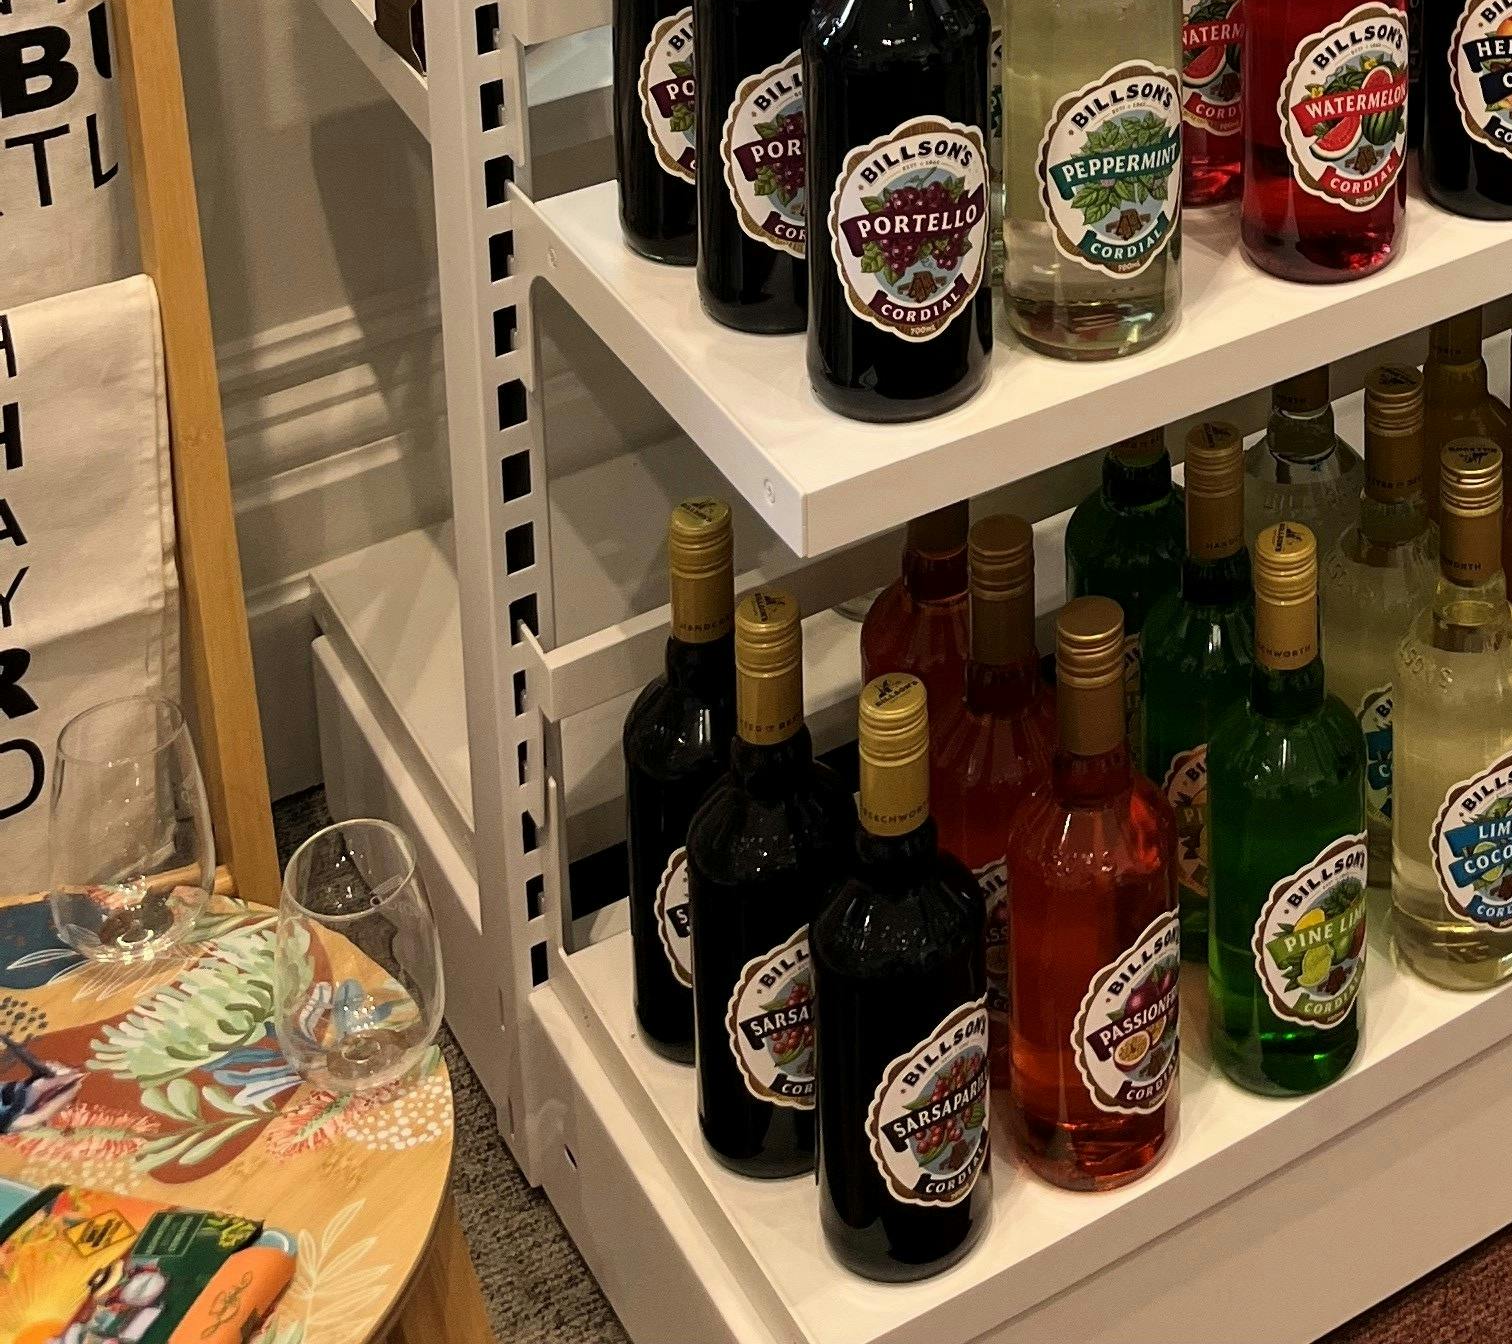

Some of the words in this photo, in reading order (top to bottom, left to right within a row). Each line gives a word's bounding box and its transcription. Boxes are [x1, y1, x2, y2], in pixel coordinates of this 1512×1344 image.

[1316, 22, 1404, 72] BILLSON'S
[1071, 82, 1174, 130] BILLSON'S
[1304, 82, 1407, 119] WATERMELON
[860, 139, 974, 185] BILLSON'S
[1061, 142, 1178, 183] PEPPERMINT
[1329, 160, 1399, 195] CORDIAL
[856, 204, 978, 239] PORTELLO
[1089, 228, 1163, 261] CORDIAL
[880, 292, 961, 324] CORDIAL
[1284, 922, 1334, 953] PINE
